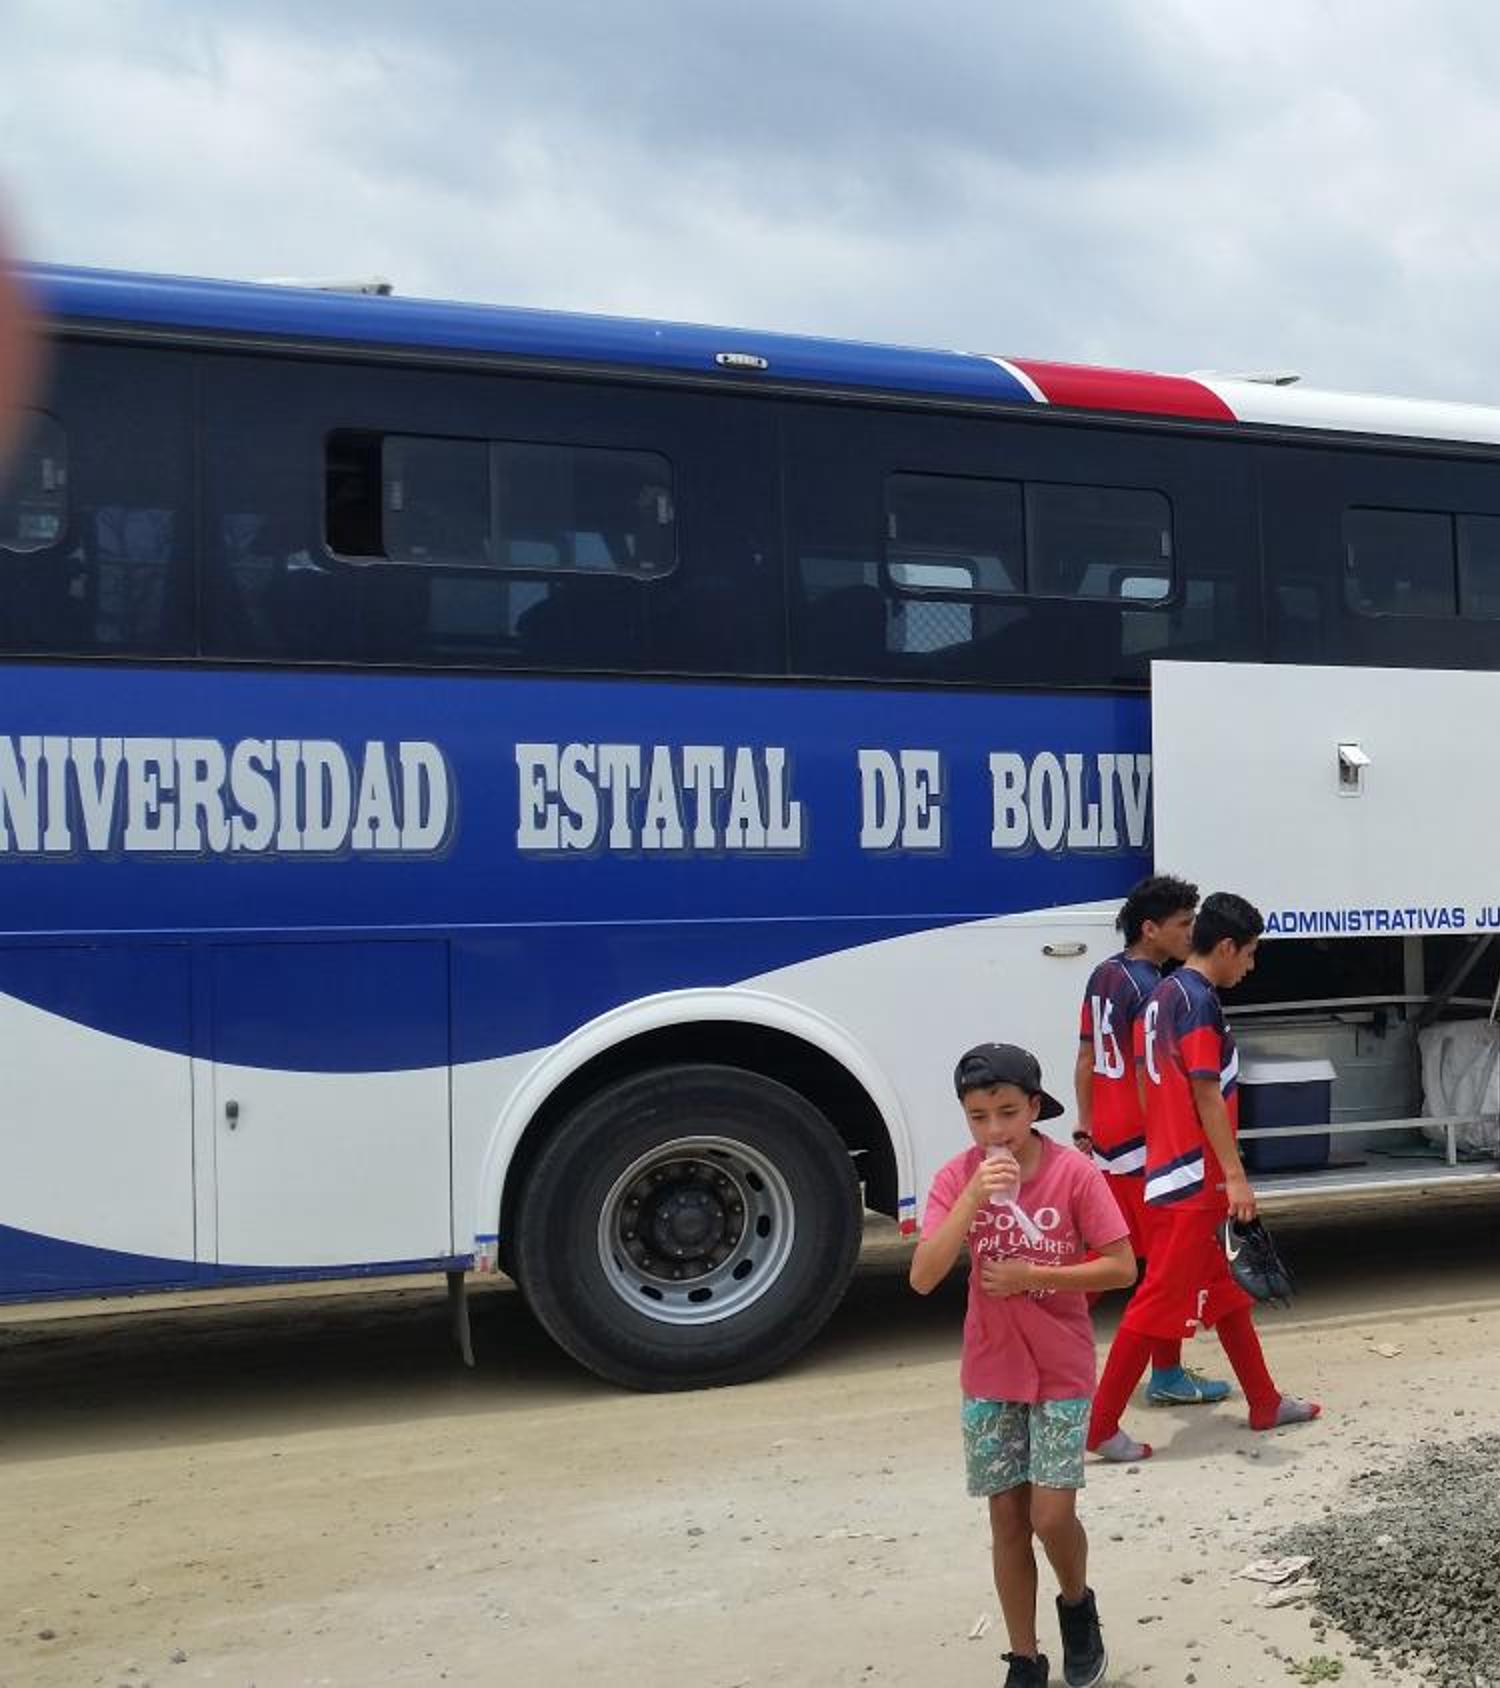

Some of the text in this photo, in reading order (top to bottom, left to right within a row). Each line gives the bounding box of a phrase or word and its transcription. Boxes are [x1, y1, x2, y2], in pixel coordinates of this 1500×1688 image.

[0, 736, 1151, 853] NIVERSIDAD ESTATAL DE BOLIV
[1265, 907, 1465, 932] ADMINISTRATIVAS
[969, 1207, 1060, 1233] POO
